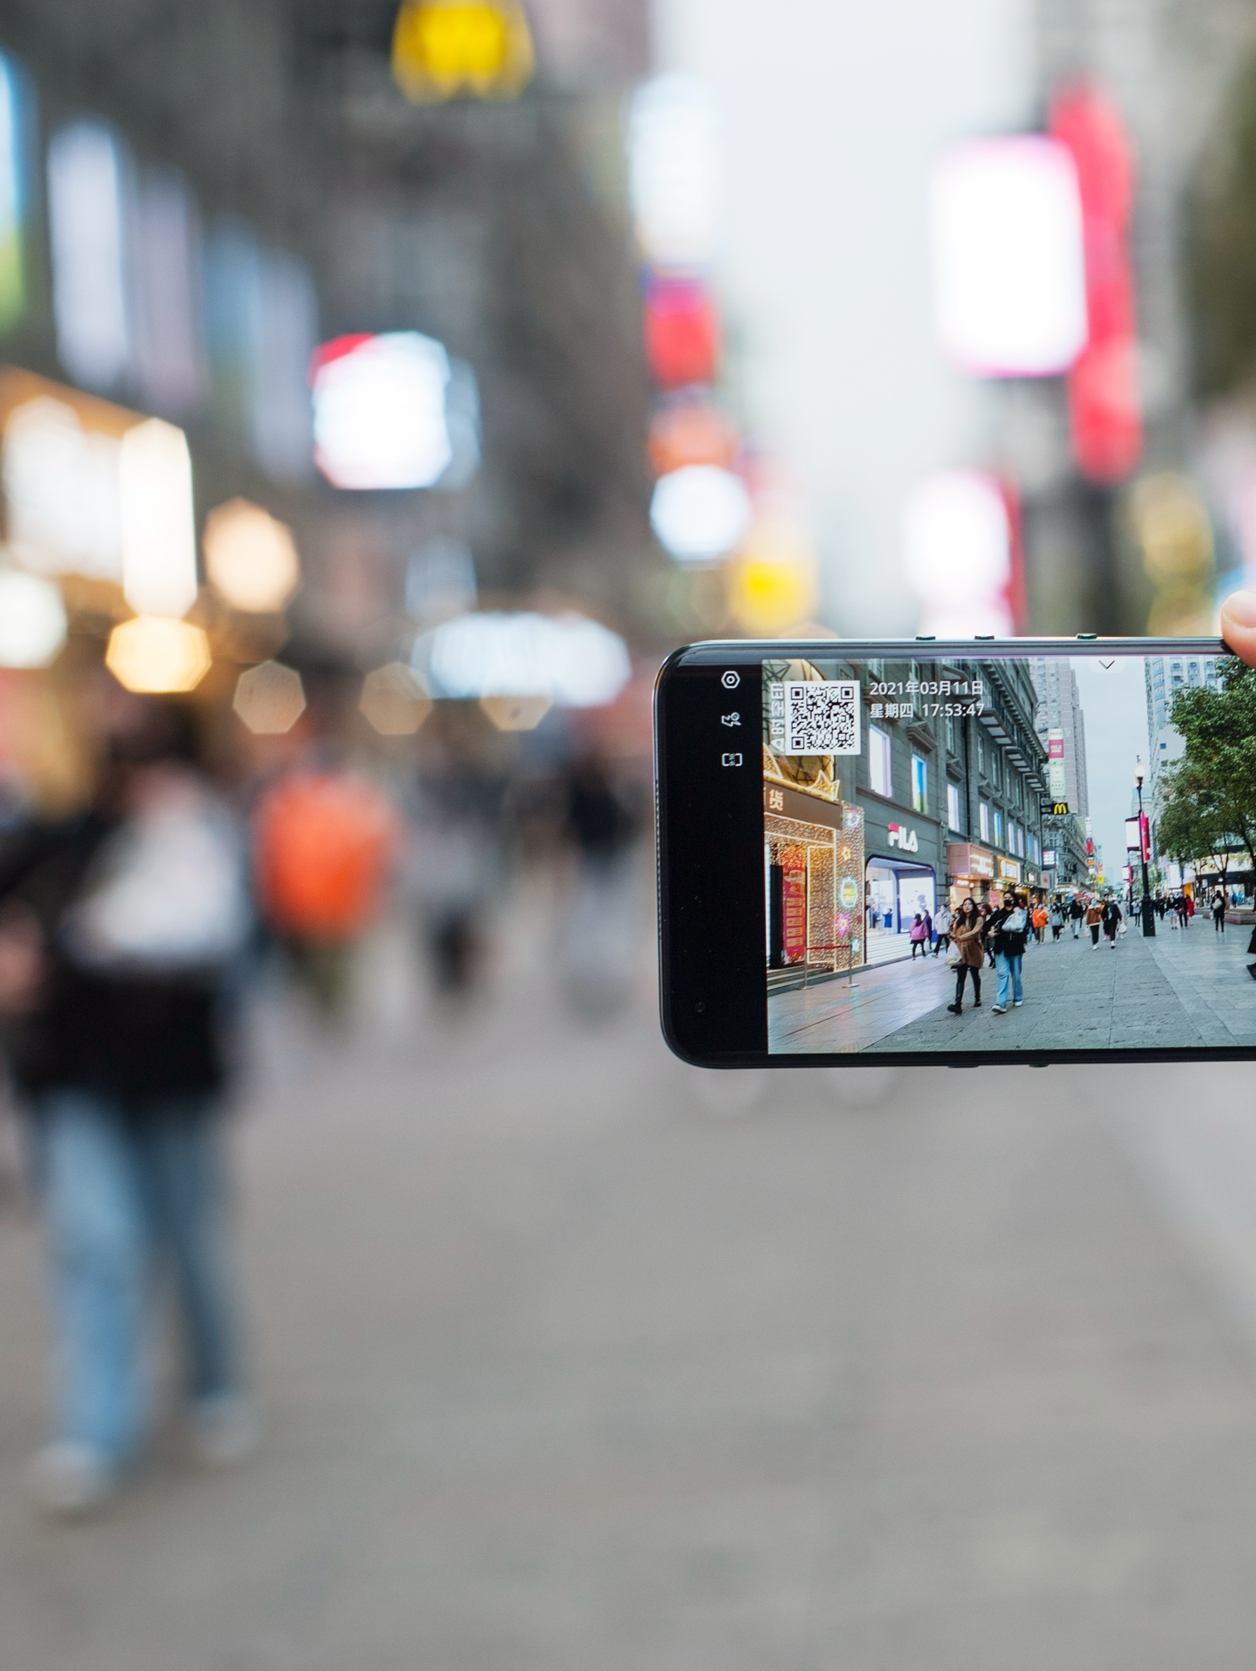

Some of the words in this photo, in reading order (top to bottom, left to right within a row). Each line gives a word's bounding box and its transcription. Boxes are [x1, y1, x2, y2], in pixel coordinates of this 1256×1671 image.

[869, 680, 983, 696] 2021年03月11日
[869, 703, 914, 718] 星期四
[922, 703, 985, 717] 17:53:47
[888, 822, 919, 853] FILA
